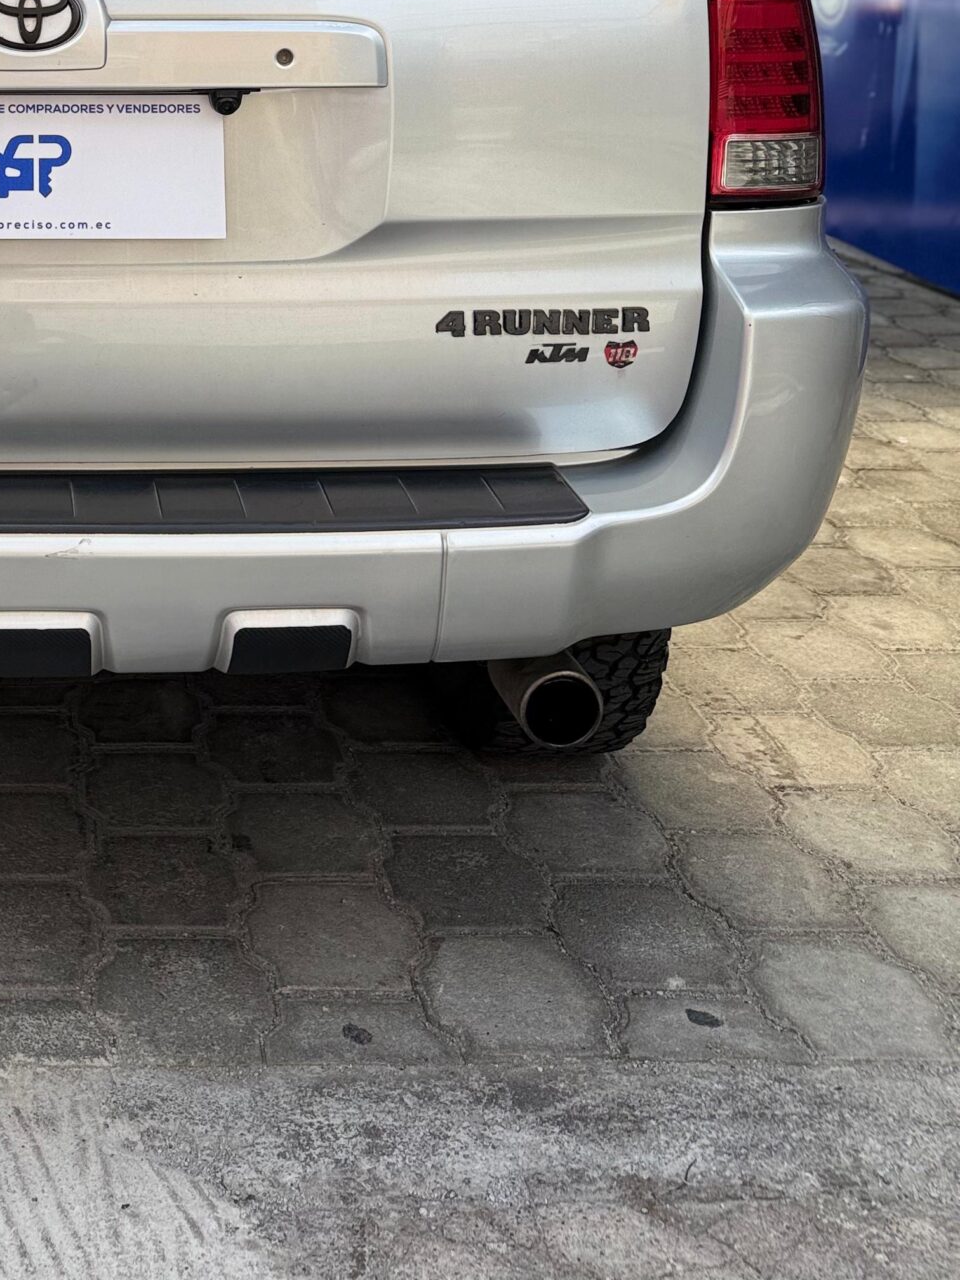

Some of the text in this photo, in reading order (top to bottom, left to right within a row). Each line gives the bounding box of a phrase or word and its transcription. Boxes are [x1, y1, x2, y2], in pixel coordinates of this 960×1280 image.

[8, 104, 104, 114] COMPRADORES
[106, 104, 115, 114] Y
[116, 104, 201, 114] VENDEDORES
[473, 306, 650, 336] RUNNER
[525, 342, 589, 364] KTM
